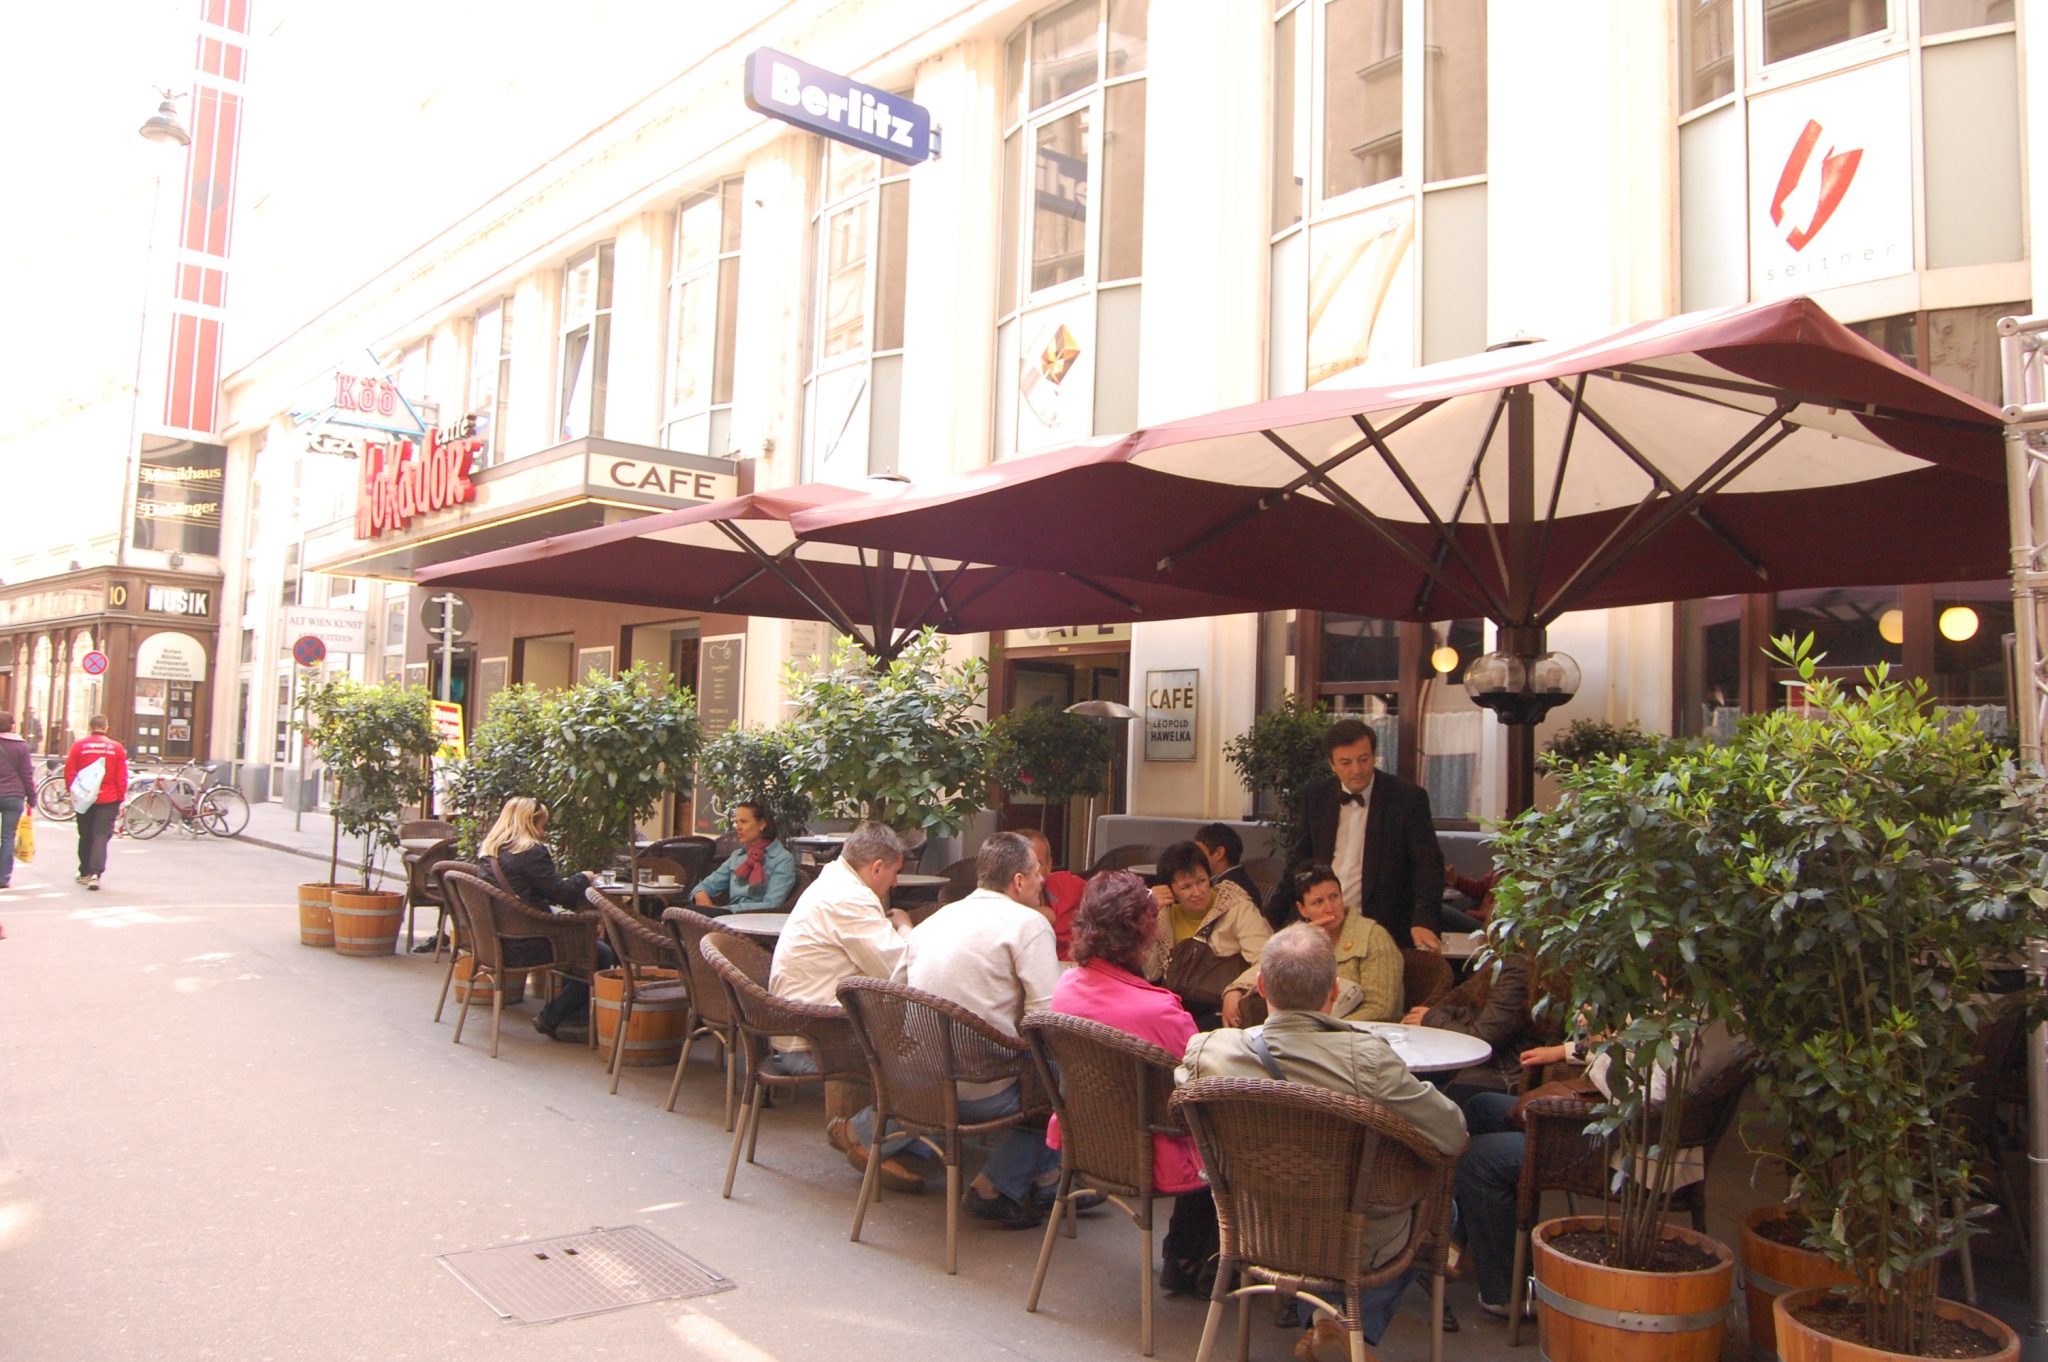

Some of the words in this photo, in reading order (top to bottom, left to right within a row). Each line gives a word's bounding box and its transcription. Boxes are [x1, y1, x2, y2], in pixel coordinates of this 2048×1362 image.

[771, 62, 914, 148] Berlitz
[335, 372, 398, 416] Köö
[609, 461, 716, 500] CAFE
[109, 586, 127, 606] 10
[149, 587, 208, 615] MUSIK
[289, 616, 306, 625] ALT
[308, 618, 332, 627] WIEN
[334, 620, 363, 630] KUNST
[1149, 682, 1194, 709] CAFÉ
[1153, 719, 1189, 728] LEOPOLD
[1150, 731, 1191, 742] HAWELKA
